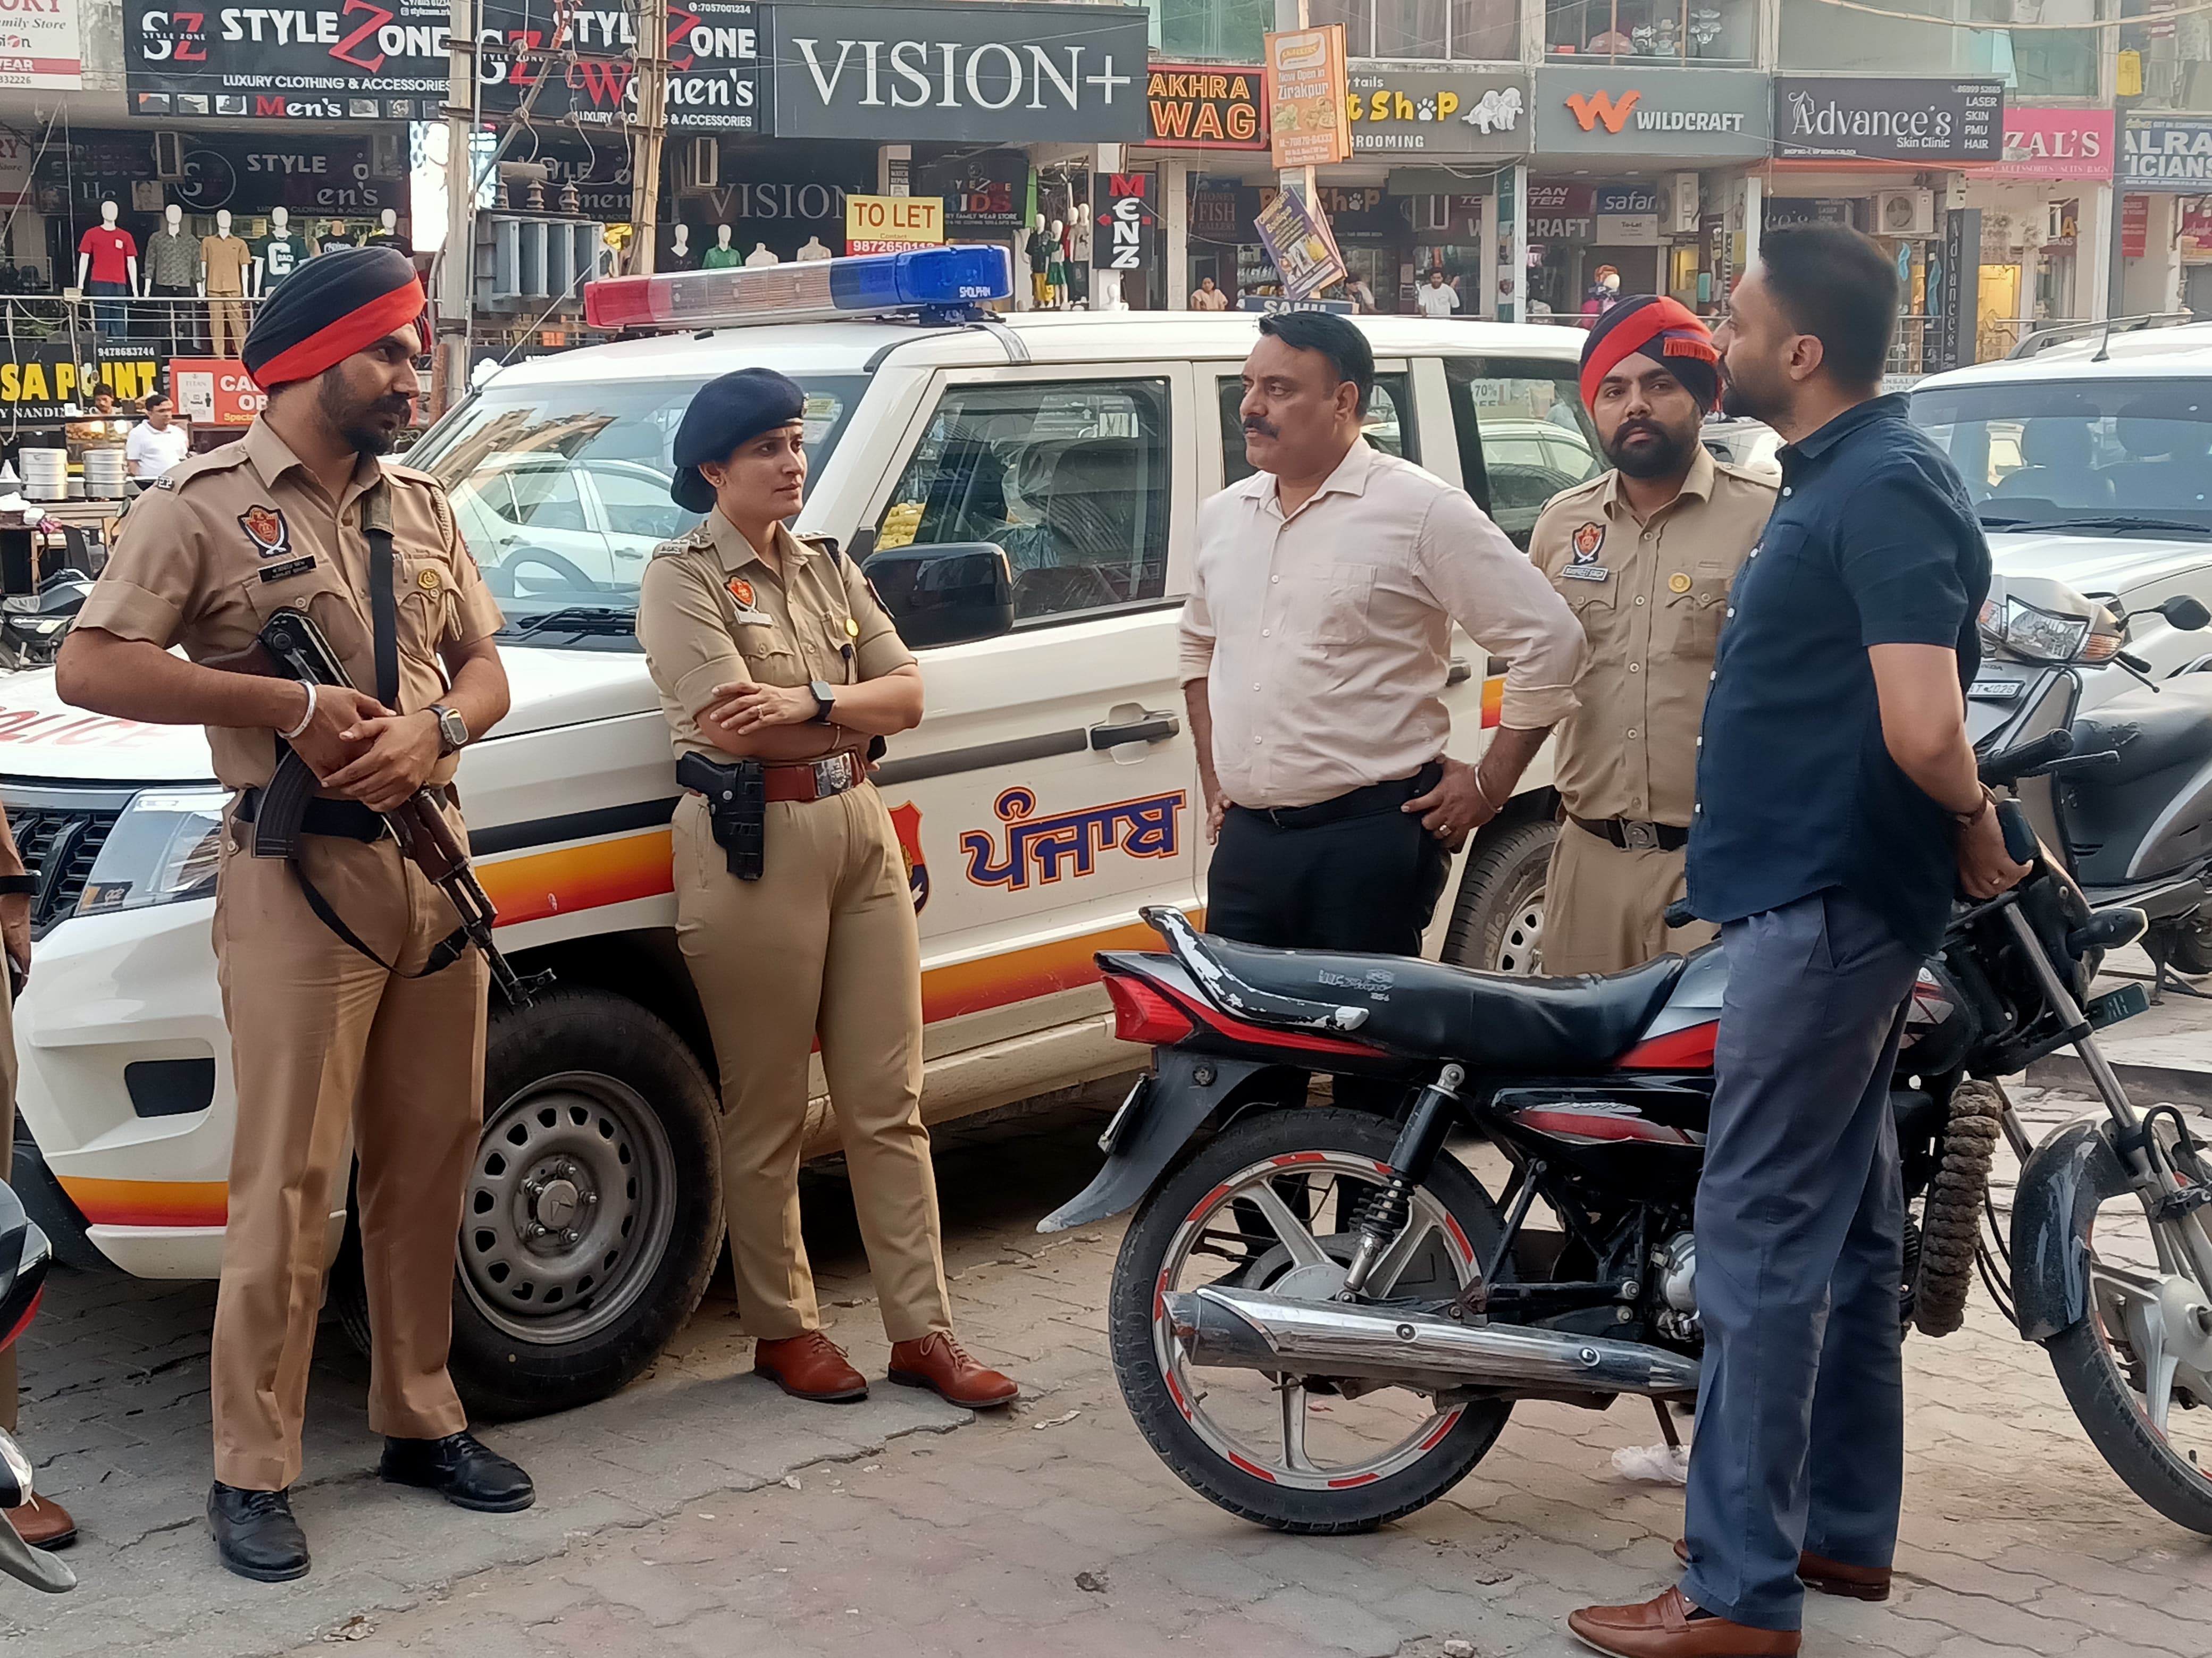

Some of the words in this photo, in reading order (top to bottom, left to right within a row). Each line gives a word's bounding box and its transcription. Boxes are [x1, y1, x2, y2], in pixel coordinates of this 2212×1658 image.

[32, 18, 66, 29] Store
[221, 9, 340, 46] STYLE
[553, 11, 640, 47] STYL
[223, 74, 275, 87] LUXURY
[275, 75, 345, 89] CLOTHING
[348, 79, 359, 90] &
[362, 79, 450, 92] ACCESSORIES
[1297, 69, 1316, 81] Open
[1353, 76, 1384, 88] tails
[1147, 73, 1251, 99] AKHRA
[1277, 82, 1329, 100] Zirakpur
[255, 95, 342, 118] Men's
[1965, 97, 1998, 107] LASER
[681, 113, 752, 127] ACCESSORIES
[1150, 100, 1256, 140] WAG
[1637, 111, 1745, 131] WILDCRAFT
[1788, 91, 1951, 136] Advance's
[1965, 111, 1989, 121] SKIN
[1964, 125, 1988, 135] PMU
[1896, 137, 1919, 148] Skin
[1921, 136, 1951, 148] Clinic
[1964, 139, 1989, 149] HAIR
[246, 154, 327, 174] STYLE
[2124, 155, 2212, 179] ICIANS
[854, 203, 885, 227] TO
[893, 204, 936, 228] LET
[1109, 174, 1146, 268] MENZ
[1199, 202, 1236, 222] FISH
[959, 786, 1186, 892] ਪੰਜਾਬ
